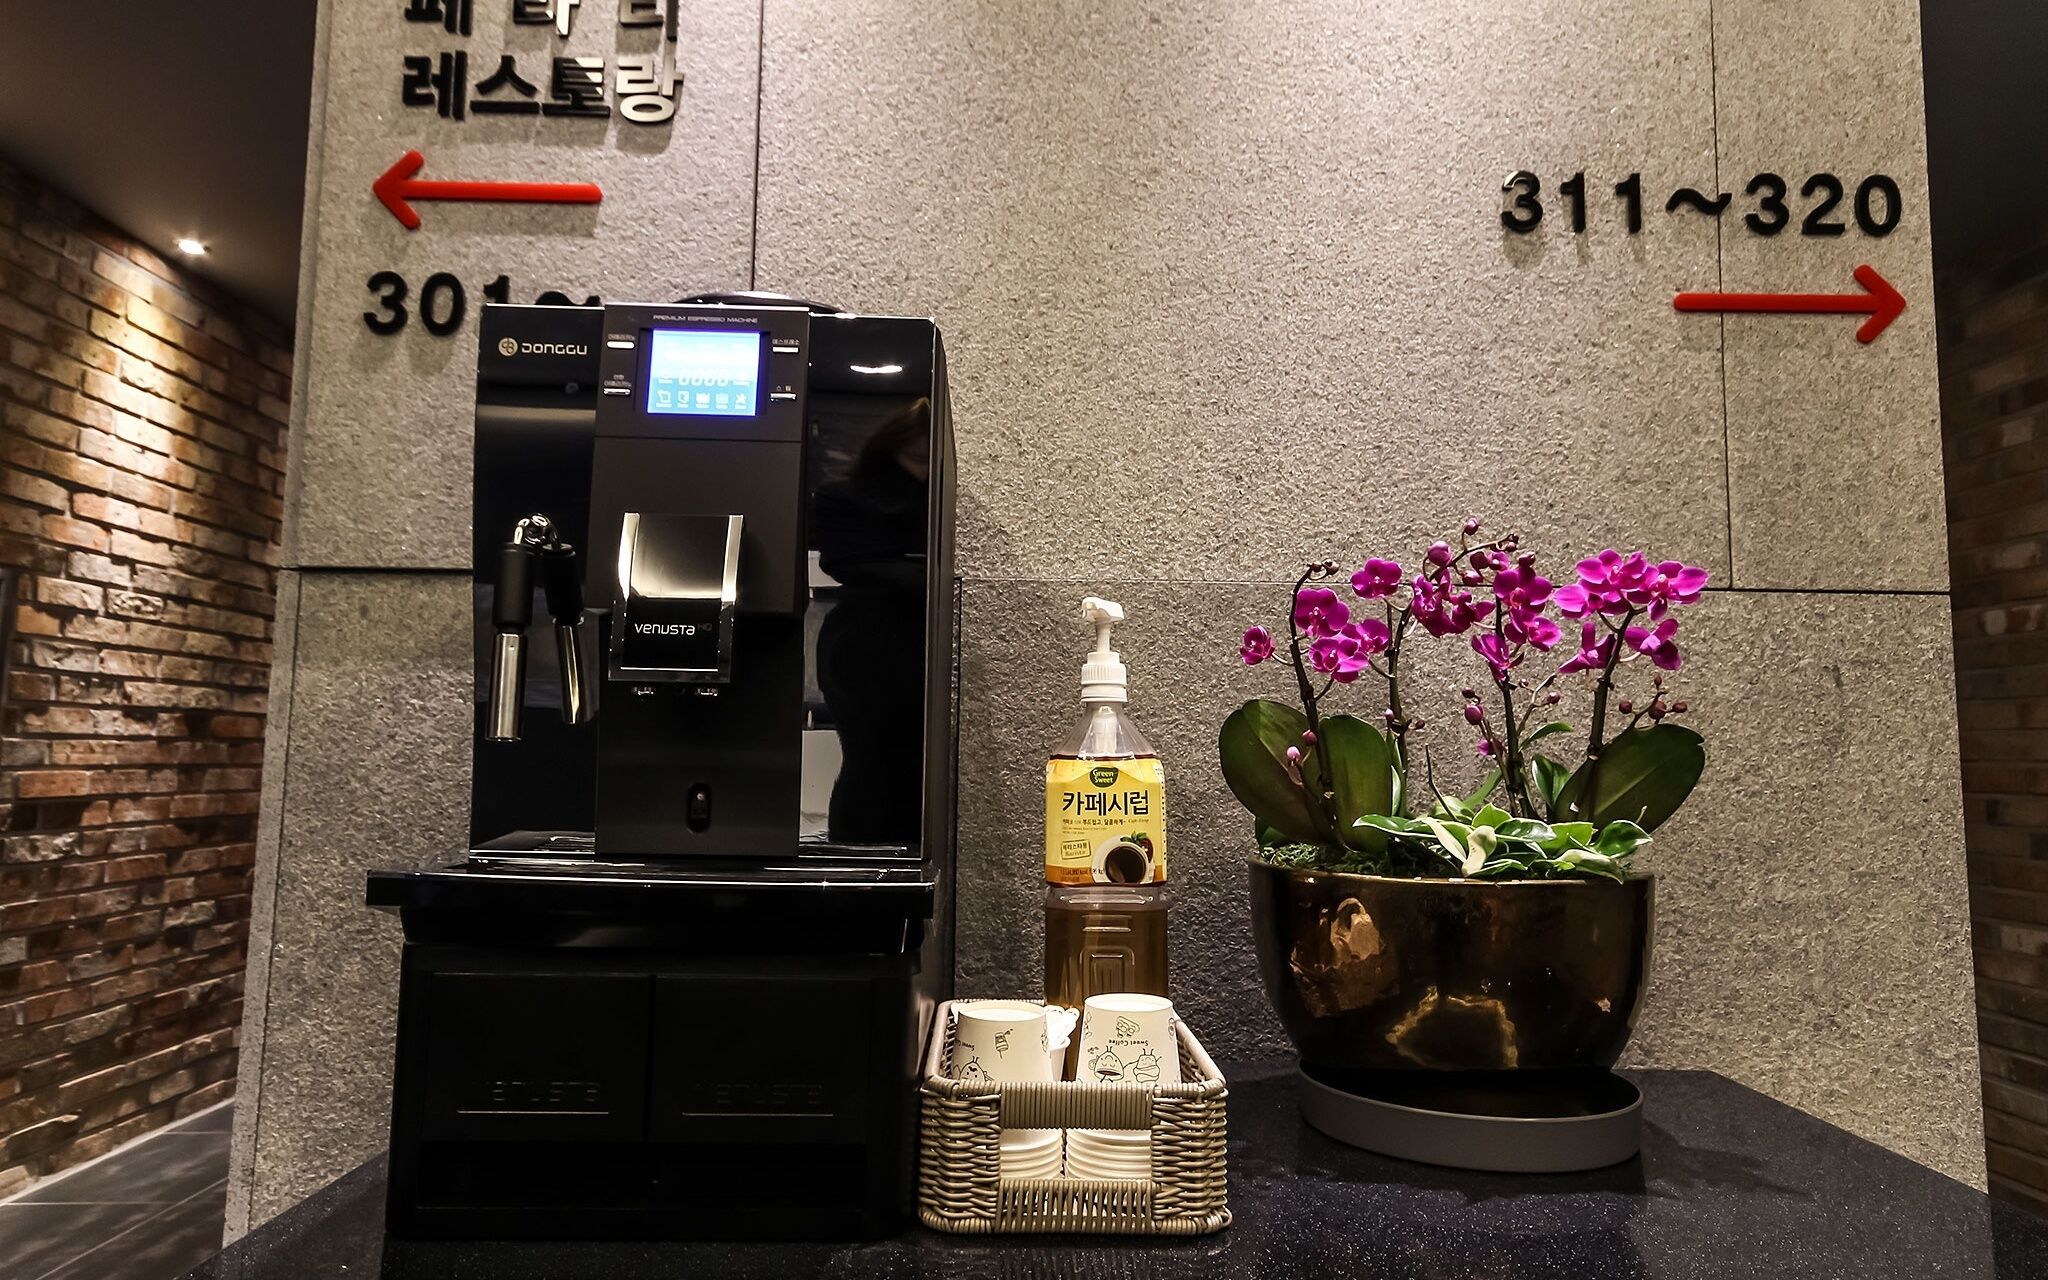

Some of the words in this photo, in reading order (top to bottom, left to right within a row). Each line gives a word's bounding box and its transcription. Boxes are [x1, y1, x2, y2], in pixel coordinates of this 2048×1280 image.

[402, 50, 684, 123] 레스토랑
[1501, 170, 1902, 237] 311~320
[687, 315, 726, 323] ESPRESSO
[521, 342, 588, 356] DONGGU
[1092, 769, 1114, 778] Green
[1094, 776, 1113, 784] Sweet
[1062, 790, 1149, 816] 카페시럽
